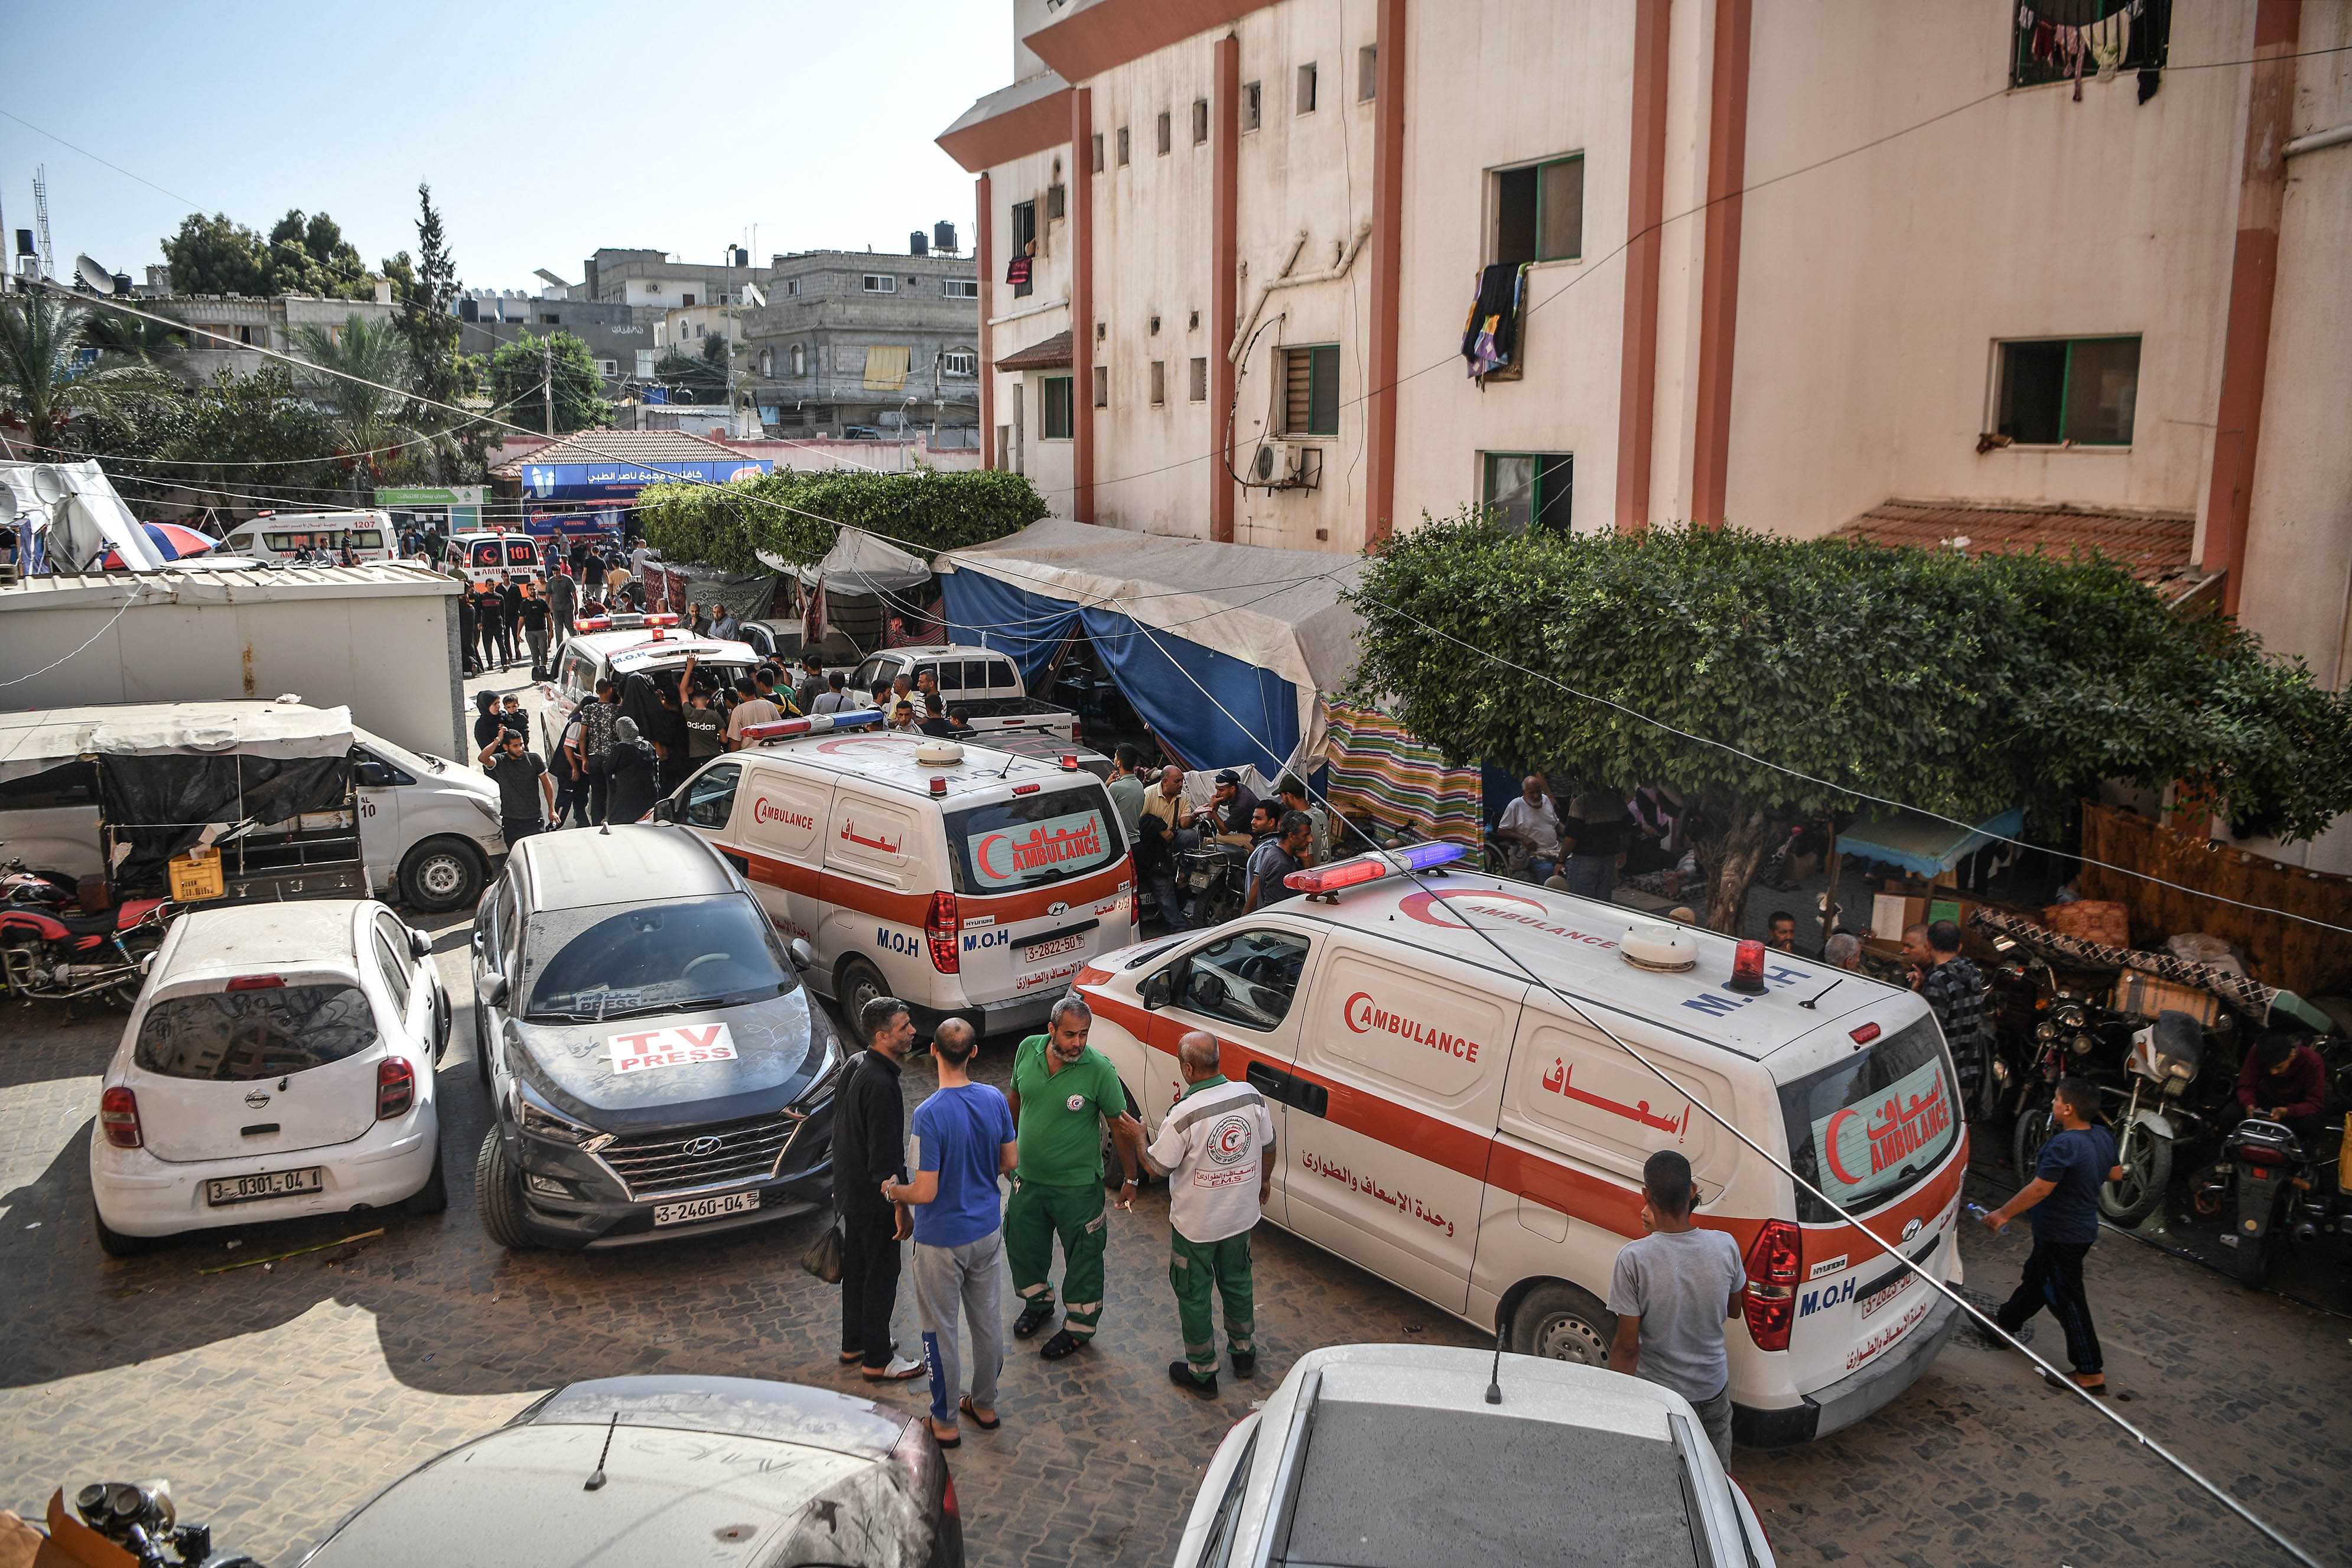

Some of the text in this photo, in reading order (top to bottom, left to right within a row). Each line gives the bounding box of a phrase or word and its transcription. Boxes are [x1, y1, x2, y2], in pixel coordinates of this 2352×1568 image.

[587, 471, 615, 484] الطبي
[617, 471, 637, 481] ناصر
[639, 471, 665, 480] مجمع
[509, 546, 529, 559] 101
[482, 567, 532, 575] AMBANCE
[611, 652, 646, 665] M.O.H
[687, 720, 716, 730] adidas
[361, 804, 376, 818] 10
[761, 805, 814, 830] AMBULANCE
[840, 818, 902, 859] إسعاف
[1013, 835, 1101, 872] AMBULANCE
[1094, 899, 1117, 916] الصحة
[966, 918, 993, 926] HYUNDAI
[1465, 905, 1619, 949] AMBULANCE
[877, 926, 919, 958] M.O.H
[963, 929, 1009, 952] M.O.H
[1028, 936, 1075, 959] 3-2822-50
[617, 1025, 723, 1055] T.V
[1360, 1005, 1479, 1063] AMBULANCE
[621, 1047, 731, 1071] PRESS
[1542, 1056, 1691, 1144] إسعاف
[1870, 1097, 1950, 1176] AMBULANCE
[1212, 1176, 1241, 1186] E.M.S
[1302, 1150, 1454, 1238] وحدة الإسعاف والطوارئ
[659, 1195, 744, 1222] 3-2460-04
[1813, 1258, 1846, 1276] HYUNDAI
[1799, 1276, 1856, 1318] M.O.H
